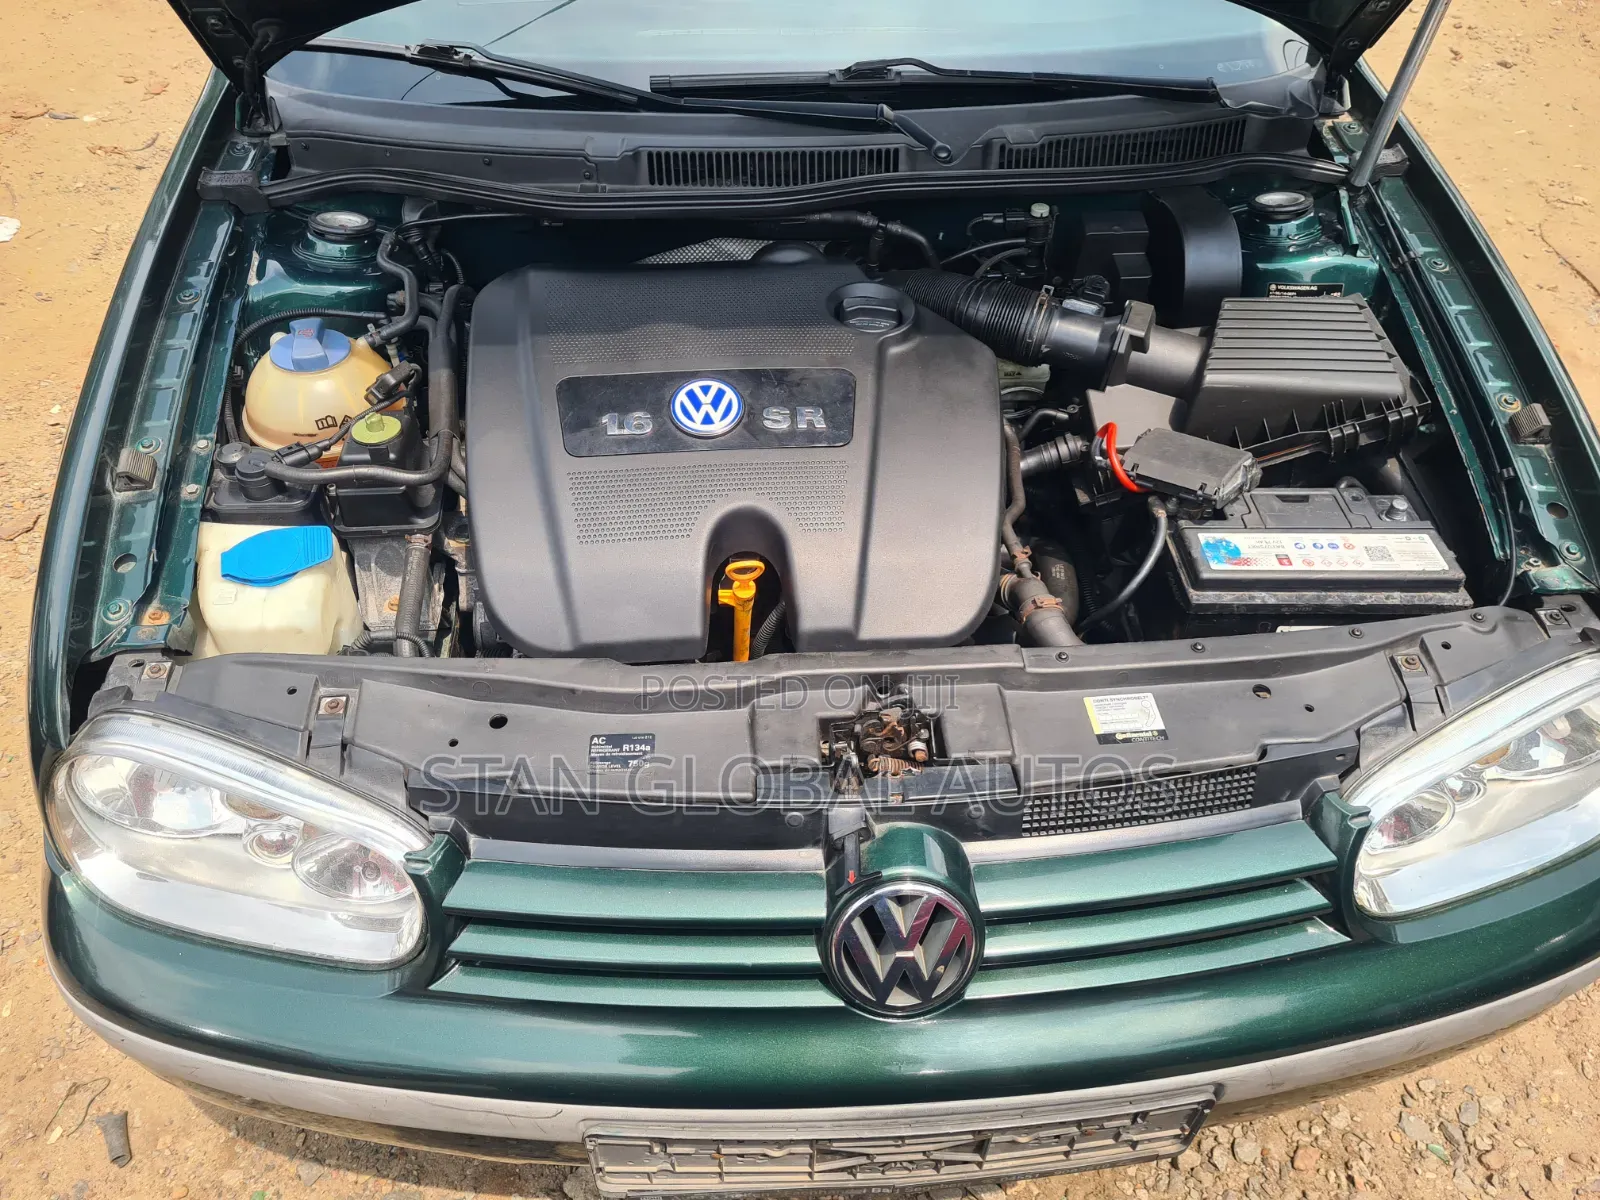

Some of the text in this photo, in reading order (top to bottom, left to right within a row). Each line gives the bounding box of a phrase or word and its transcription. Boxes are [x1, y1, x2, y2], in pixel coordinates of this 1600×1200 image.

[762, 406, 827, 429] SR
[1115, 730, 1153, 740] Continental
[622, 744, 651, 752] R134a
